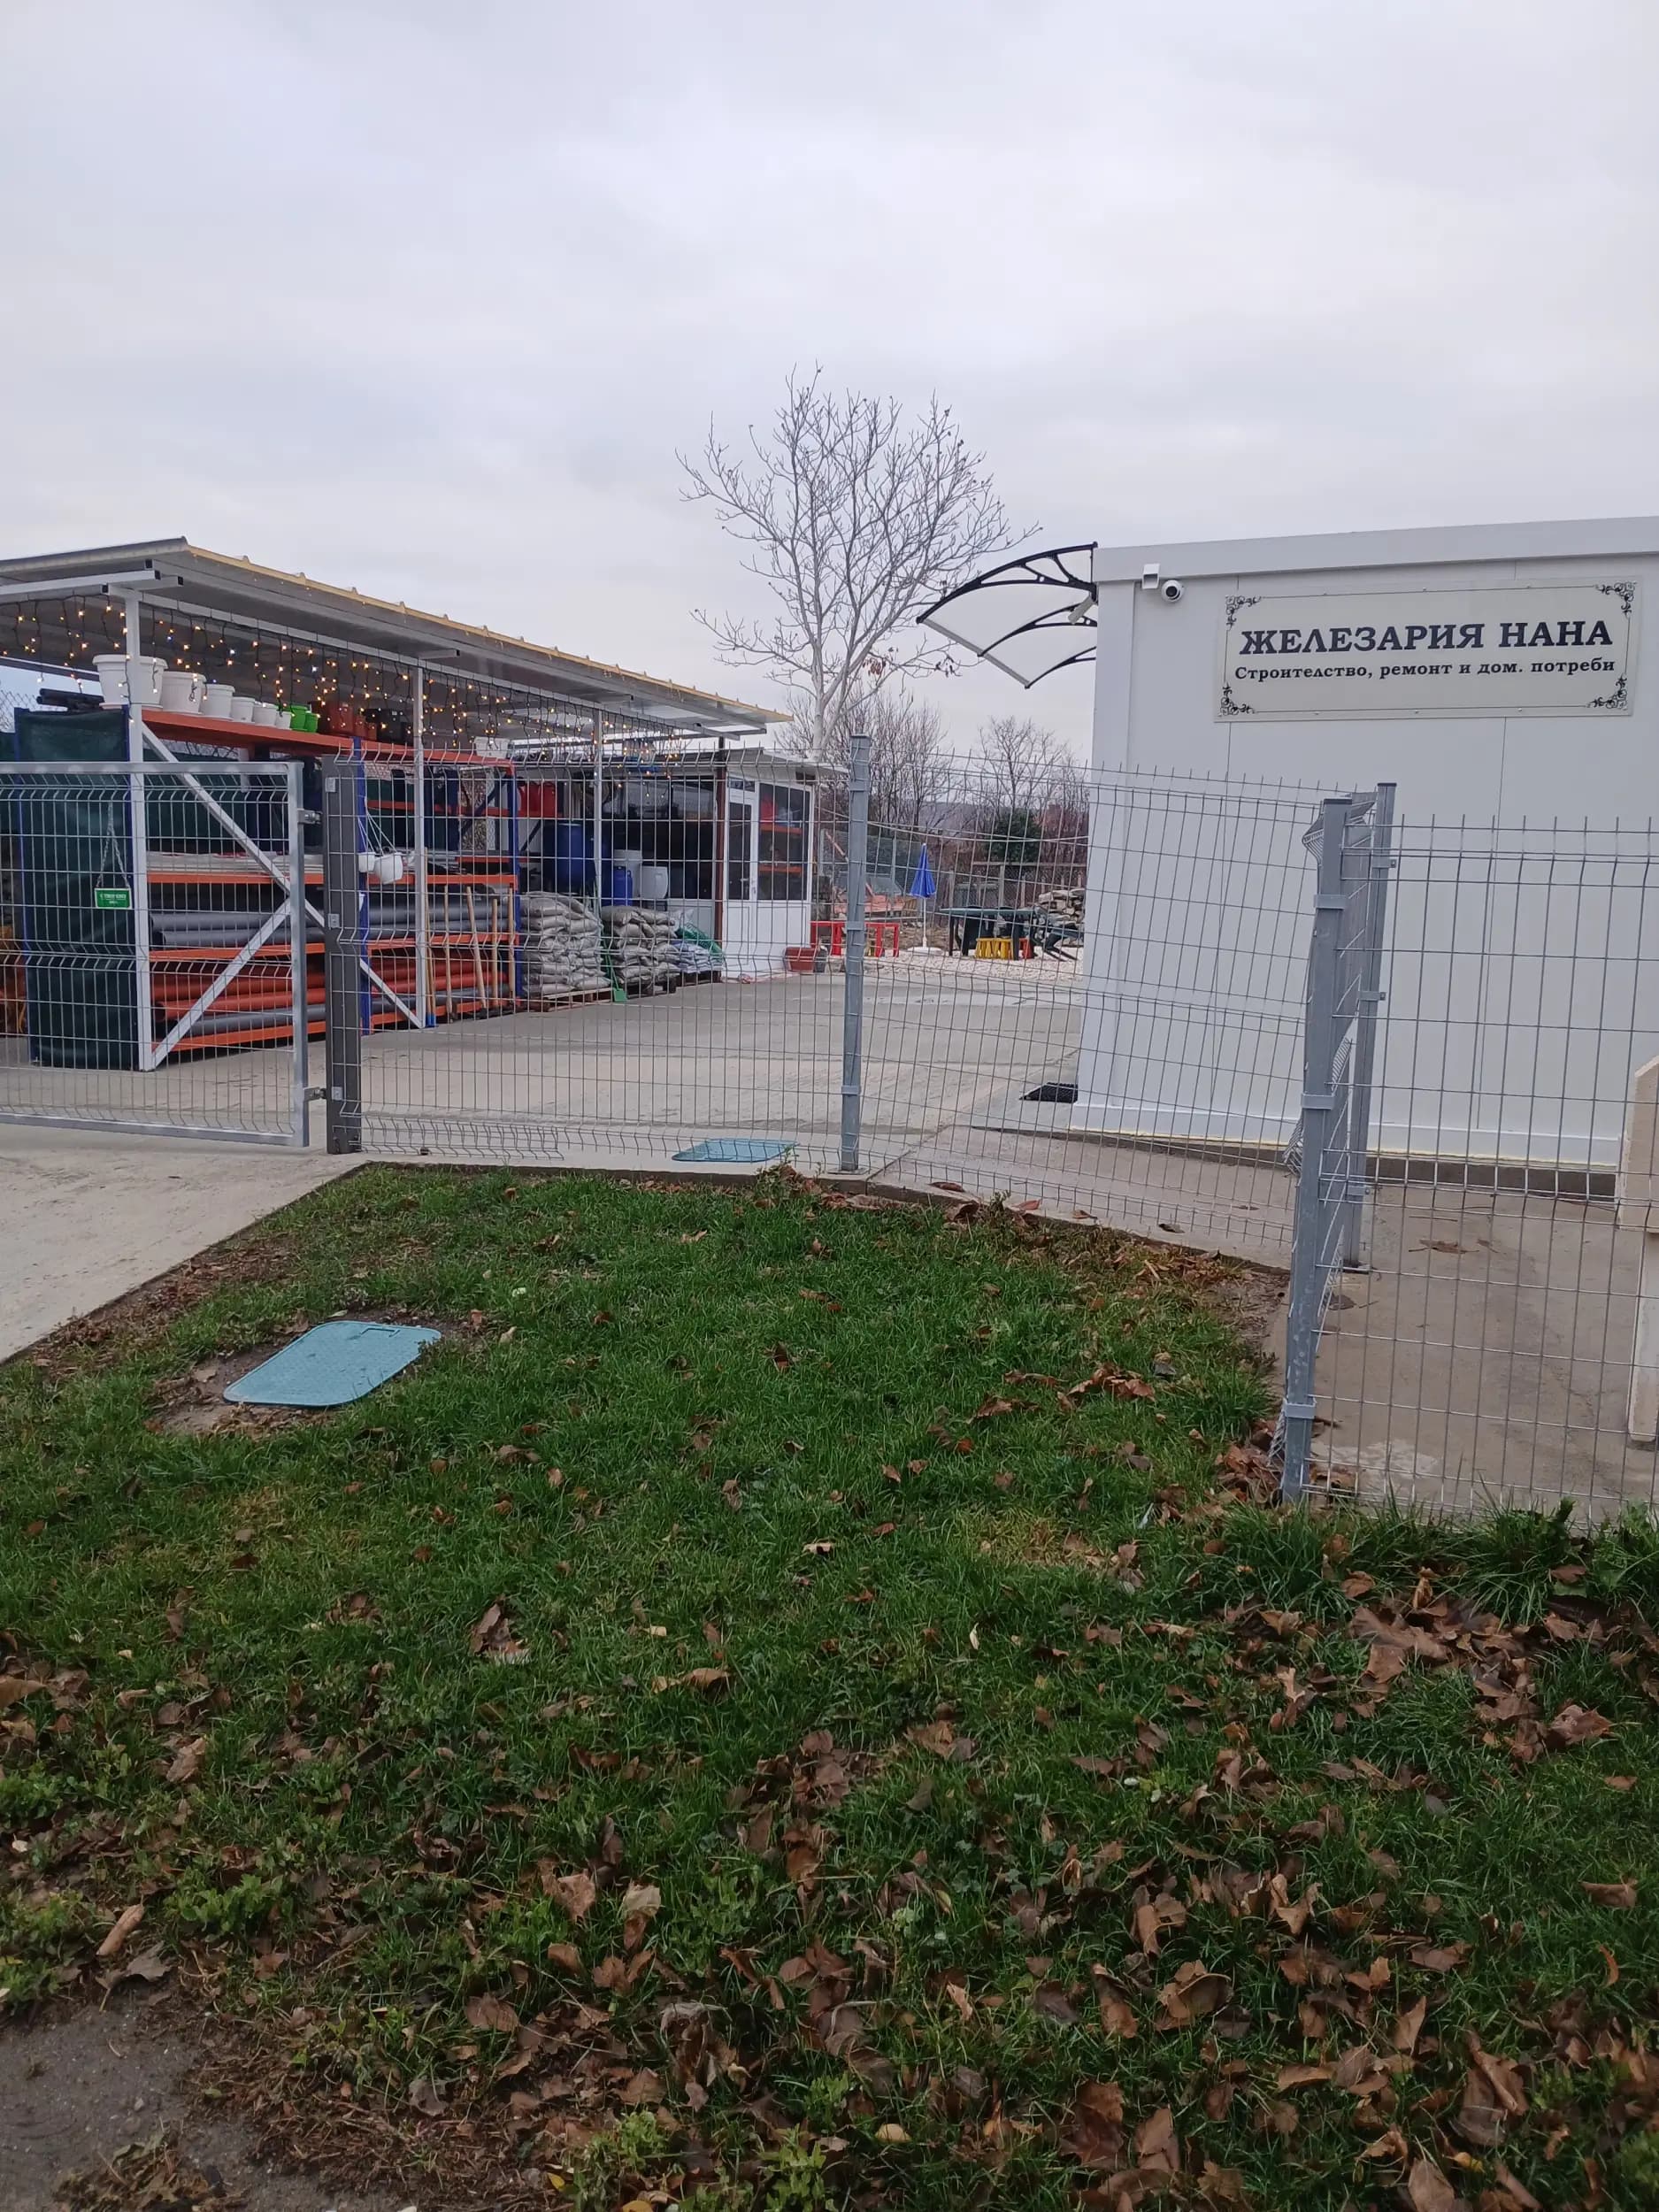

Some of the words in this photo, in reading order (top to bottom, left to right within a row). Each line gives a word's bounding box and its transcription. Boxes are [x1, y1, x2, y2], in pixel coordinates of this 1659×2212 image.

[1239, 623, 1486, 656] ЖЕЛЕЗАРИЯ
[1498, 619, 1614, 648] НАНА
[1234, 666, 1373, 683] Строителство,
[1379, 664, 1453, 680] ремонт
[1458, 664, 1471, 674] и
[1476, 663, 1523, 675] дом.
[1530, 657, 1616, 676] потреби
